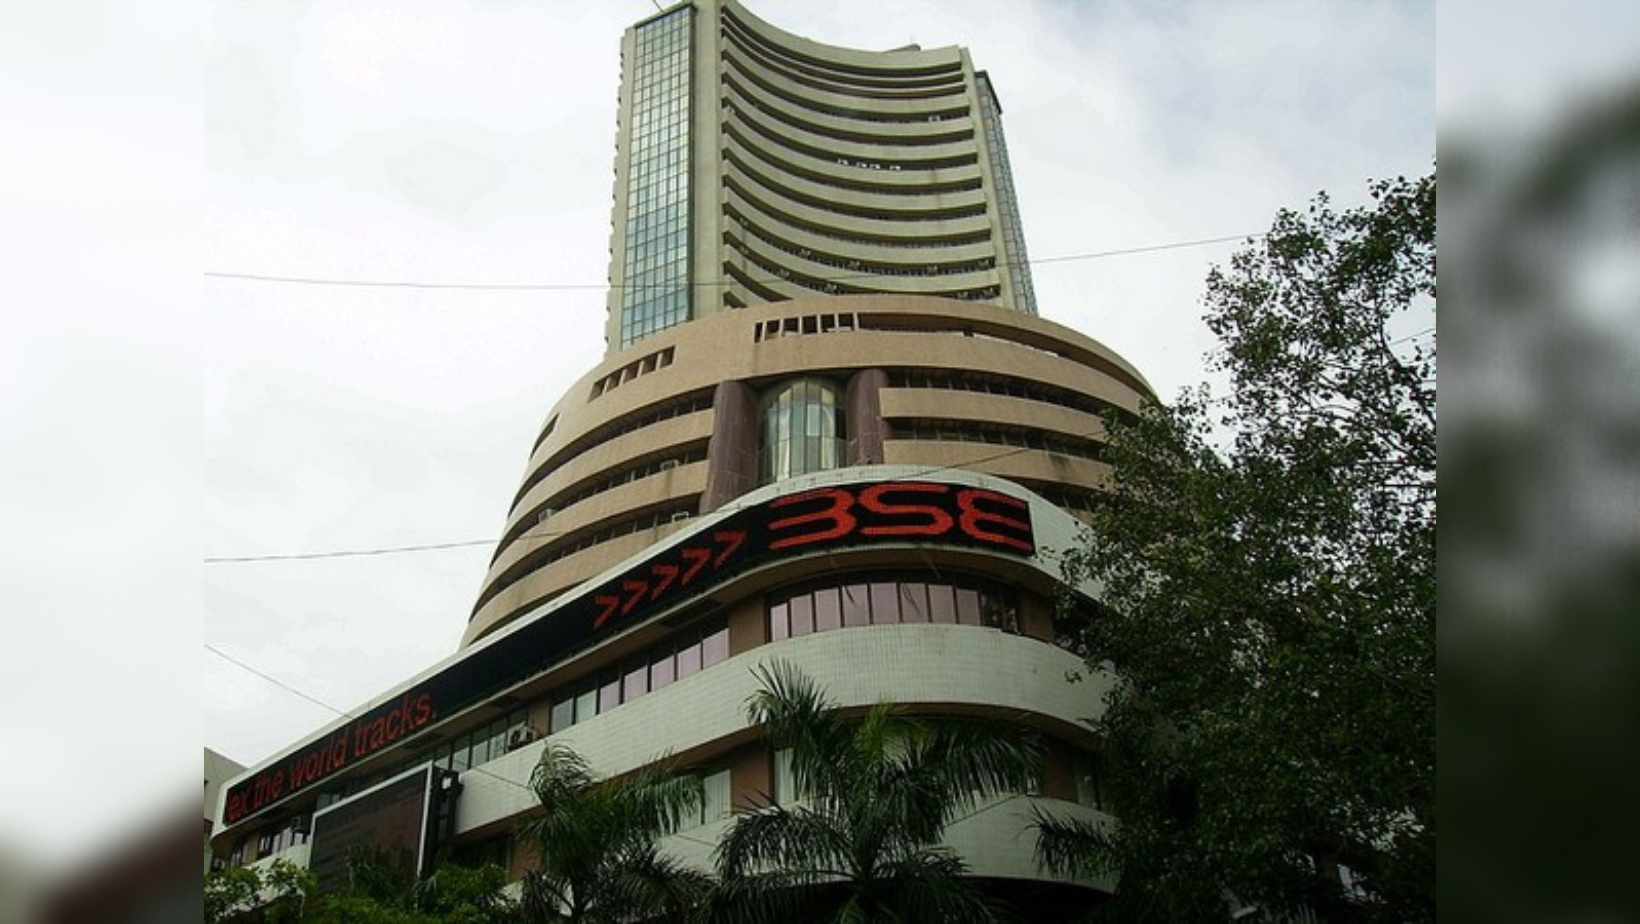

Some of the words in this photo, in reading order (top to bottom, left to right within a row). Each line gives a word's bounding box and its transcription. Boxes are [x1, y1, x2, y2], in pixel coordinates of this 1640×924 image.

[254, 770, 284, 809] the
[290, 731, 348, 787] world
[355, 692, 436, 756] tracks.
